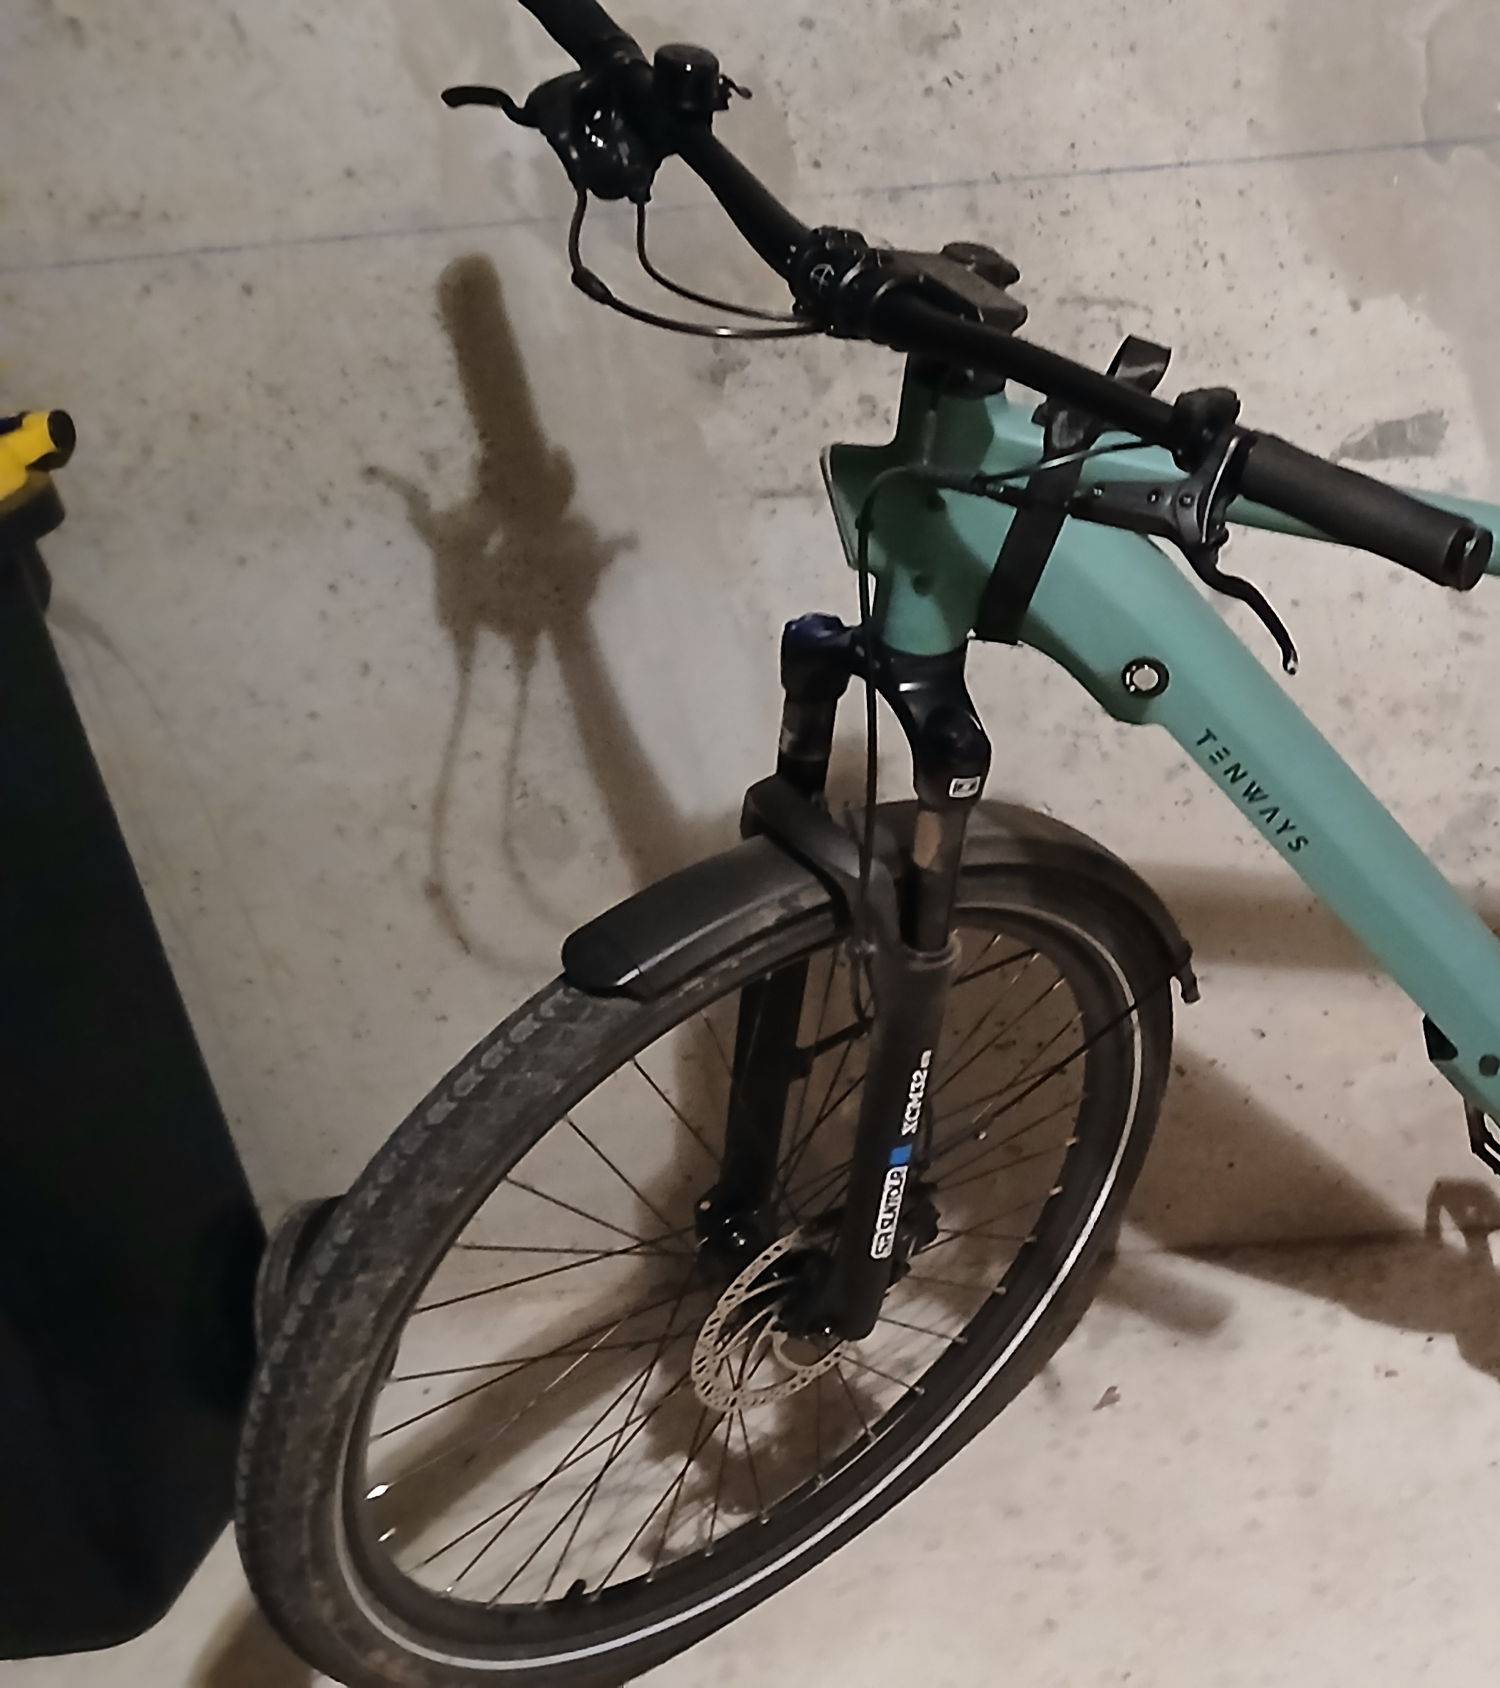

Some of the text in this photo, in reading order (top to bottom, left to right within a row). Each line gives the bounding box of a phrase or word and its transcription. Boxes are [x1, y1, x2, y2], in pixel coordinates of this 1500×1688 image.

[1196, 728, 1309, 852] TENWAYS
[877, 1167, 908, 1233] SUNTOUR
[901, 1068, 928, 1136] XCM32
